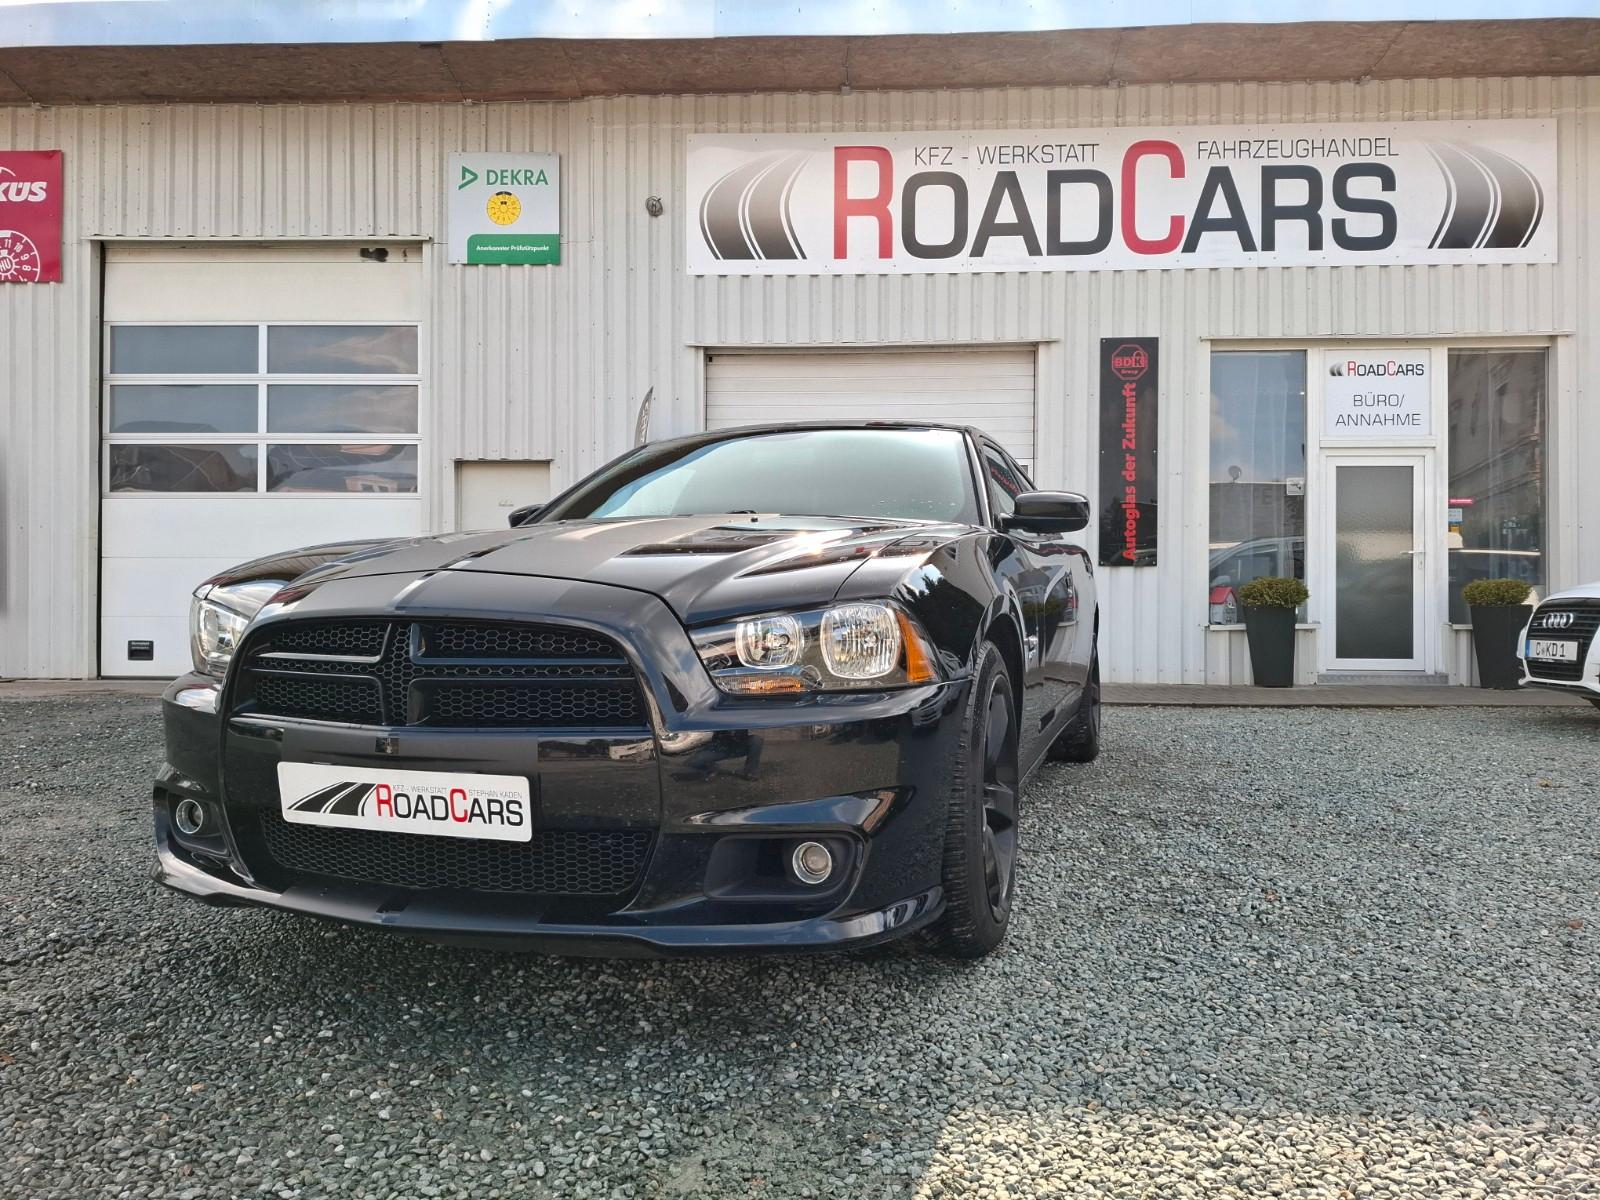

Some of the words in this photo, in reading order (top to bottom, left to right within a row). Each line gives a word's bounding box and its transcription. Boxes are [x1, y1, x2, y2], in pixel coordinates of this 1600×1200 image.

[914, 146, 953, 166] KFZ
[976, 143, 1100, 165] WERKSTATT
[1197, 137, 1399, 160] FAHRZEUGHANDEL
[486, 169, 548, 185] DEKRA
[1353, 391, 1405, 408] BÜRO/
[1122, 383, 1136, 449] Zukunft
[1335, 413, 1422, 427] ANNAHME
[1121, 454, 1136, 482] der
[1121, 486, 1140, 560] Autoglas
[1536, 642, 1541, 656] C
[1545, 642, 1558, 657] KD
[1560, 643, 1566, 657] 1
[411, 786, 448, 794] WERKSTATT
[469, 788, 498, 798] STEPHAN
[499, 791, 523, 800] KADEN
